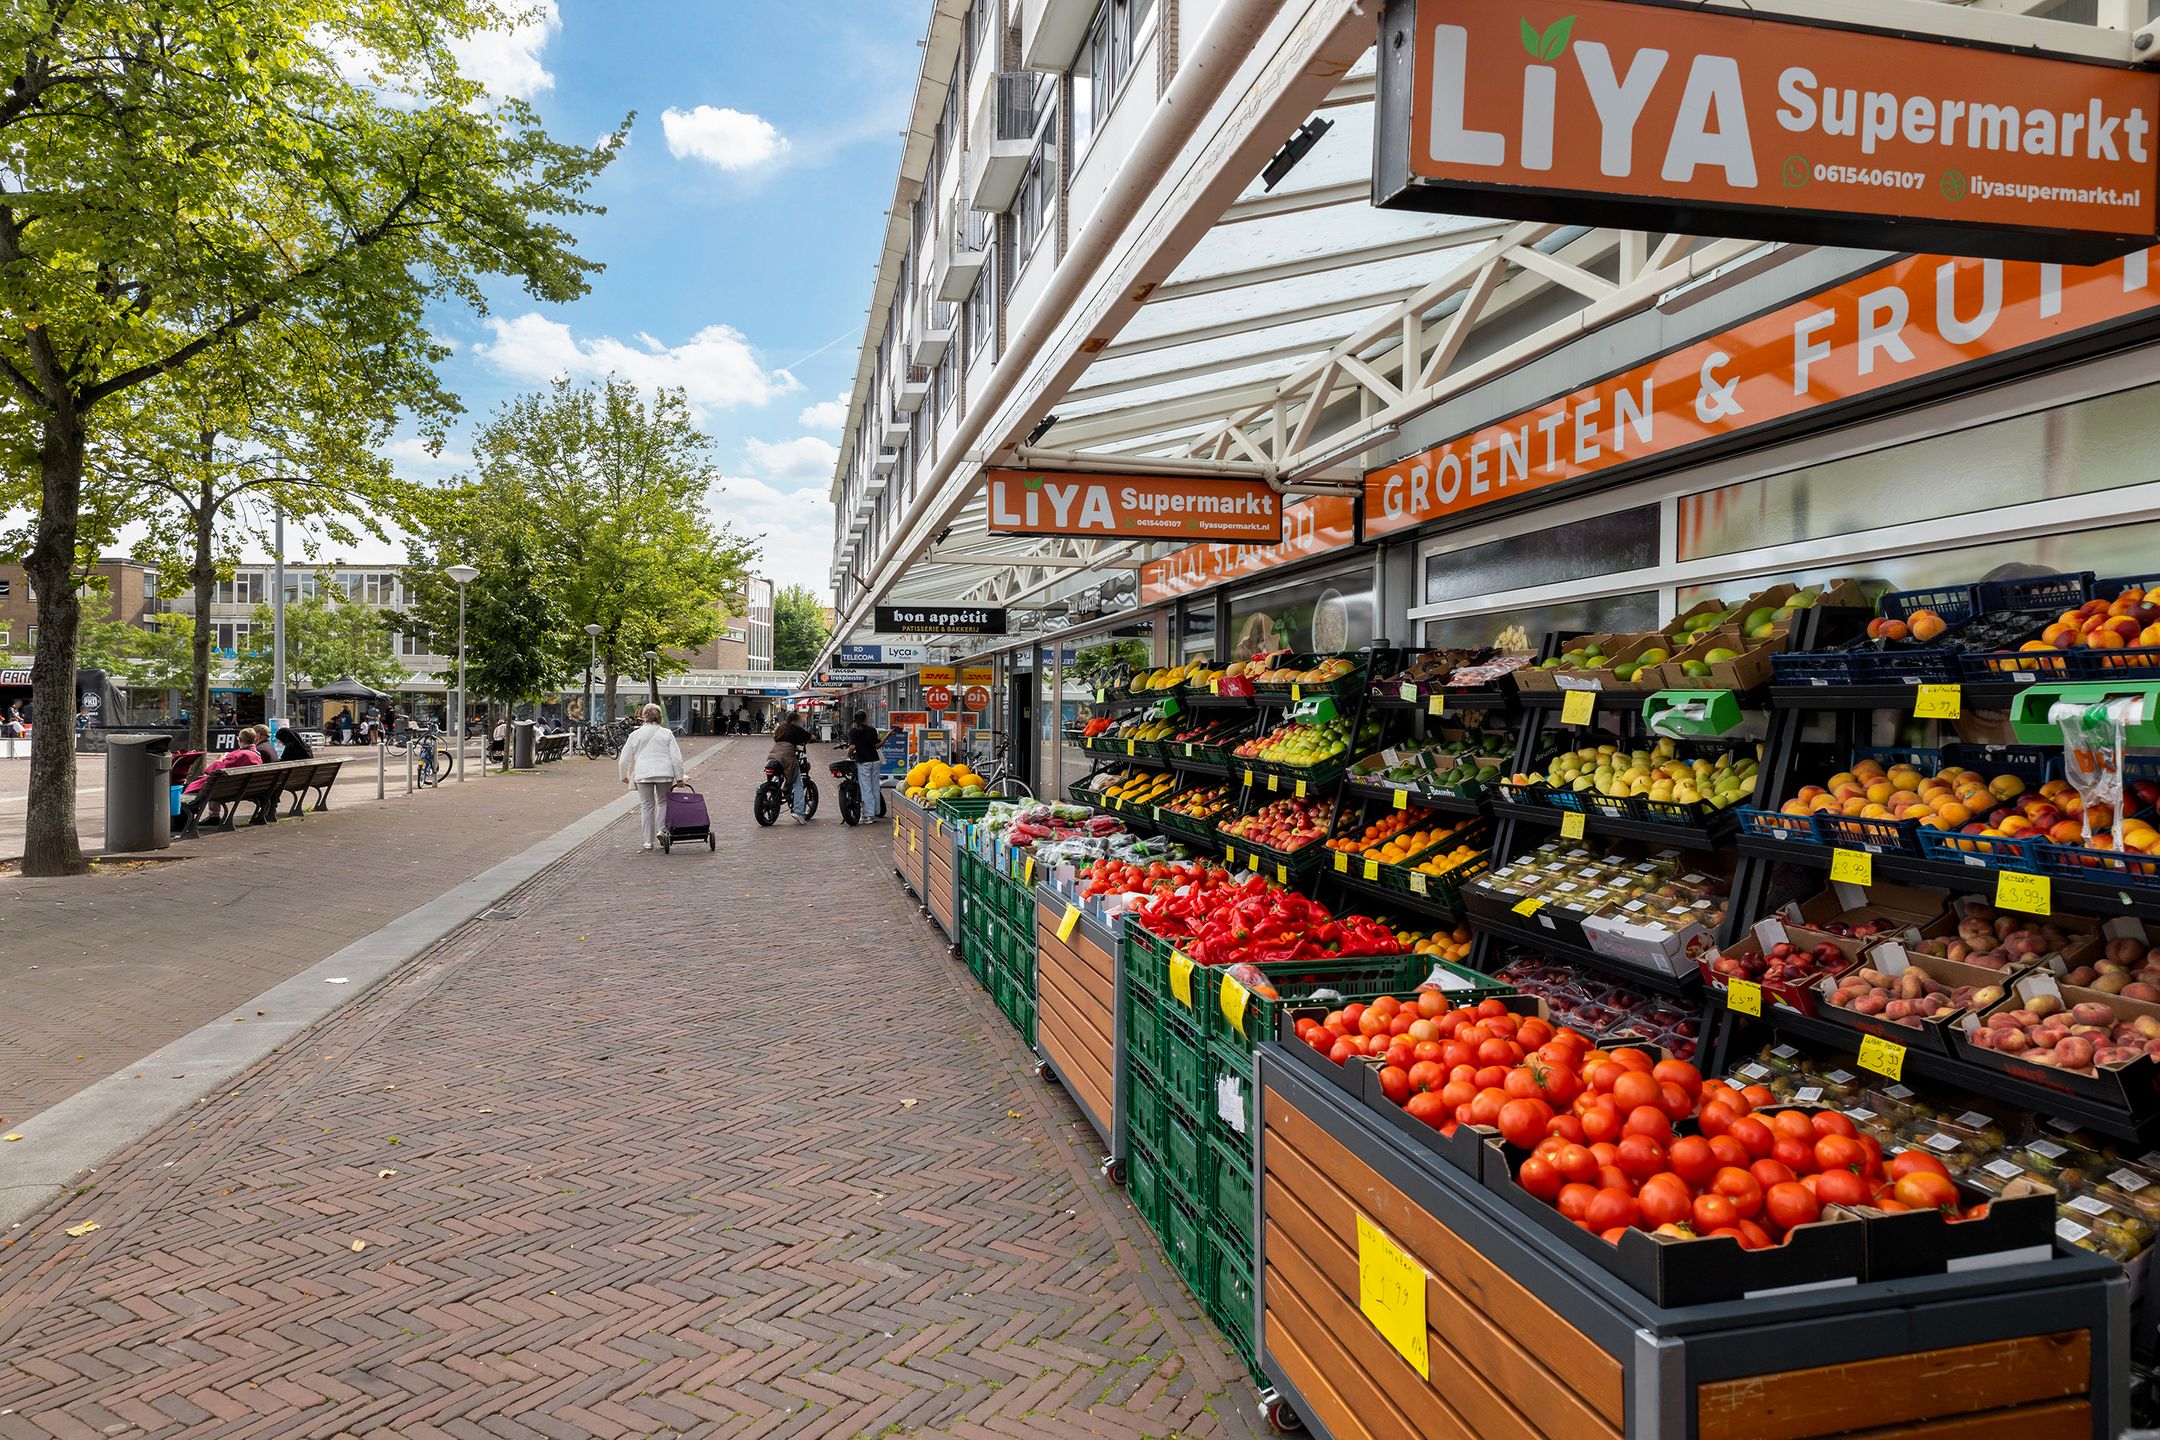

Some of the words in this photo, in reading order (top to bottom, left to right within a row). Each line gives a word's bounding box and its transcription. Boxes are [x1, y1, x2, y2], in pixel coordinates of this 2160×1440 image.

[1777, 66, 2148, 163] Supermarkt
[1814, 163, 1926, 190] 0615406107
[1970, 175, 2141, 207] liyasupermarkt.nl
[1383, 379, 1653, 521] GROENTEN
[1696, 351, 1745, 424] &
[1121, 487, 1273, 516] Supermarkt
[1136, 519, 1182, 528] 0615406107
[1199, 520, 1270, 532] liyasupermarkt.nl
[1157, 550, 1206, 593] HALAL
[893, 609, 925, 622] bon
[929, 610, 988, 626] appétit
[902, 625, 940, 633] PATISSERIE
[889, 648, 912, 657] Lyca
[929, 688, 949, 702] ria
